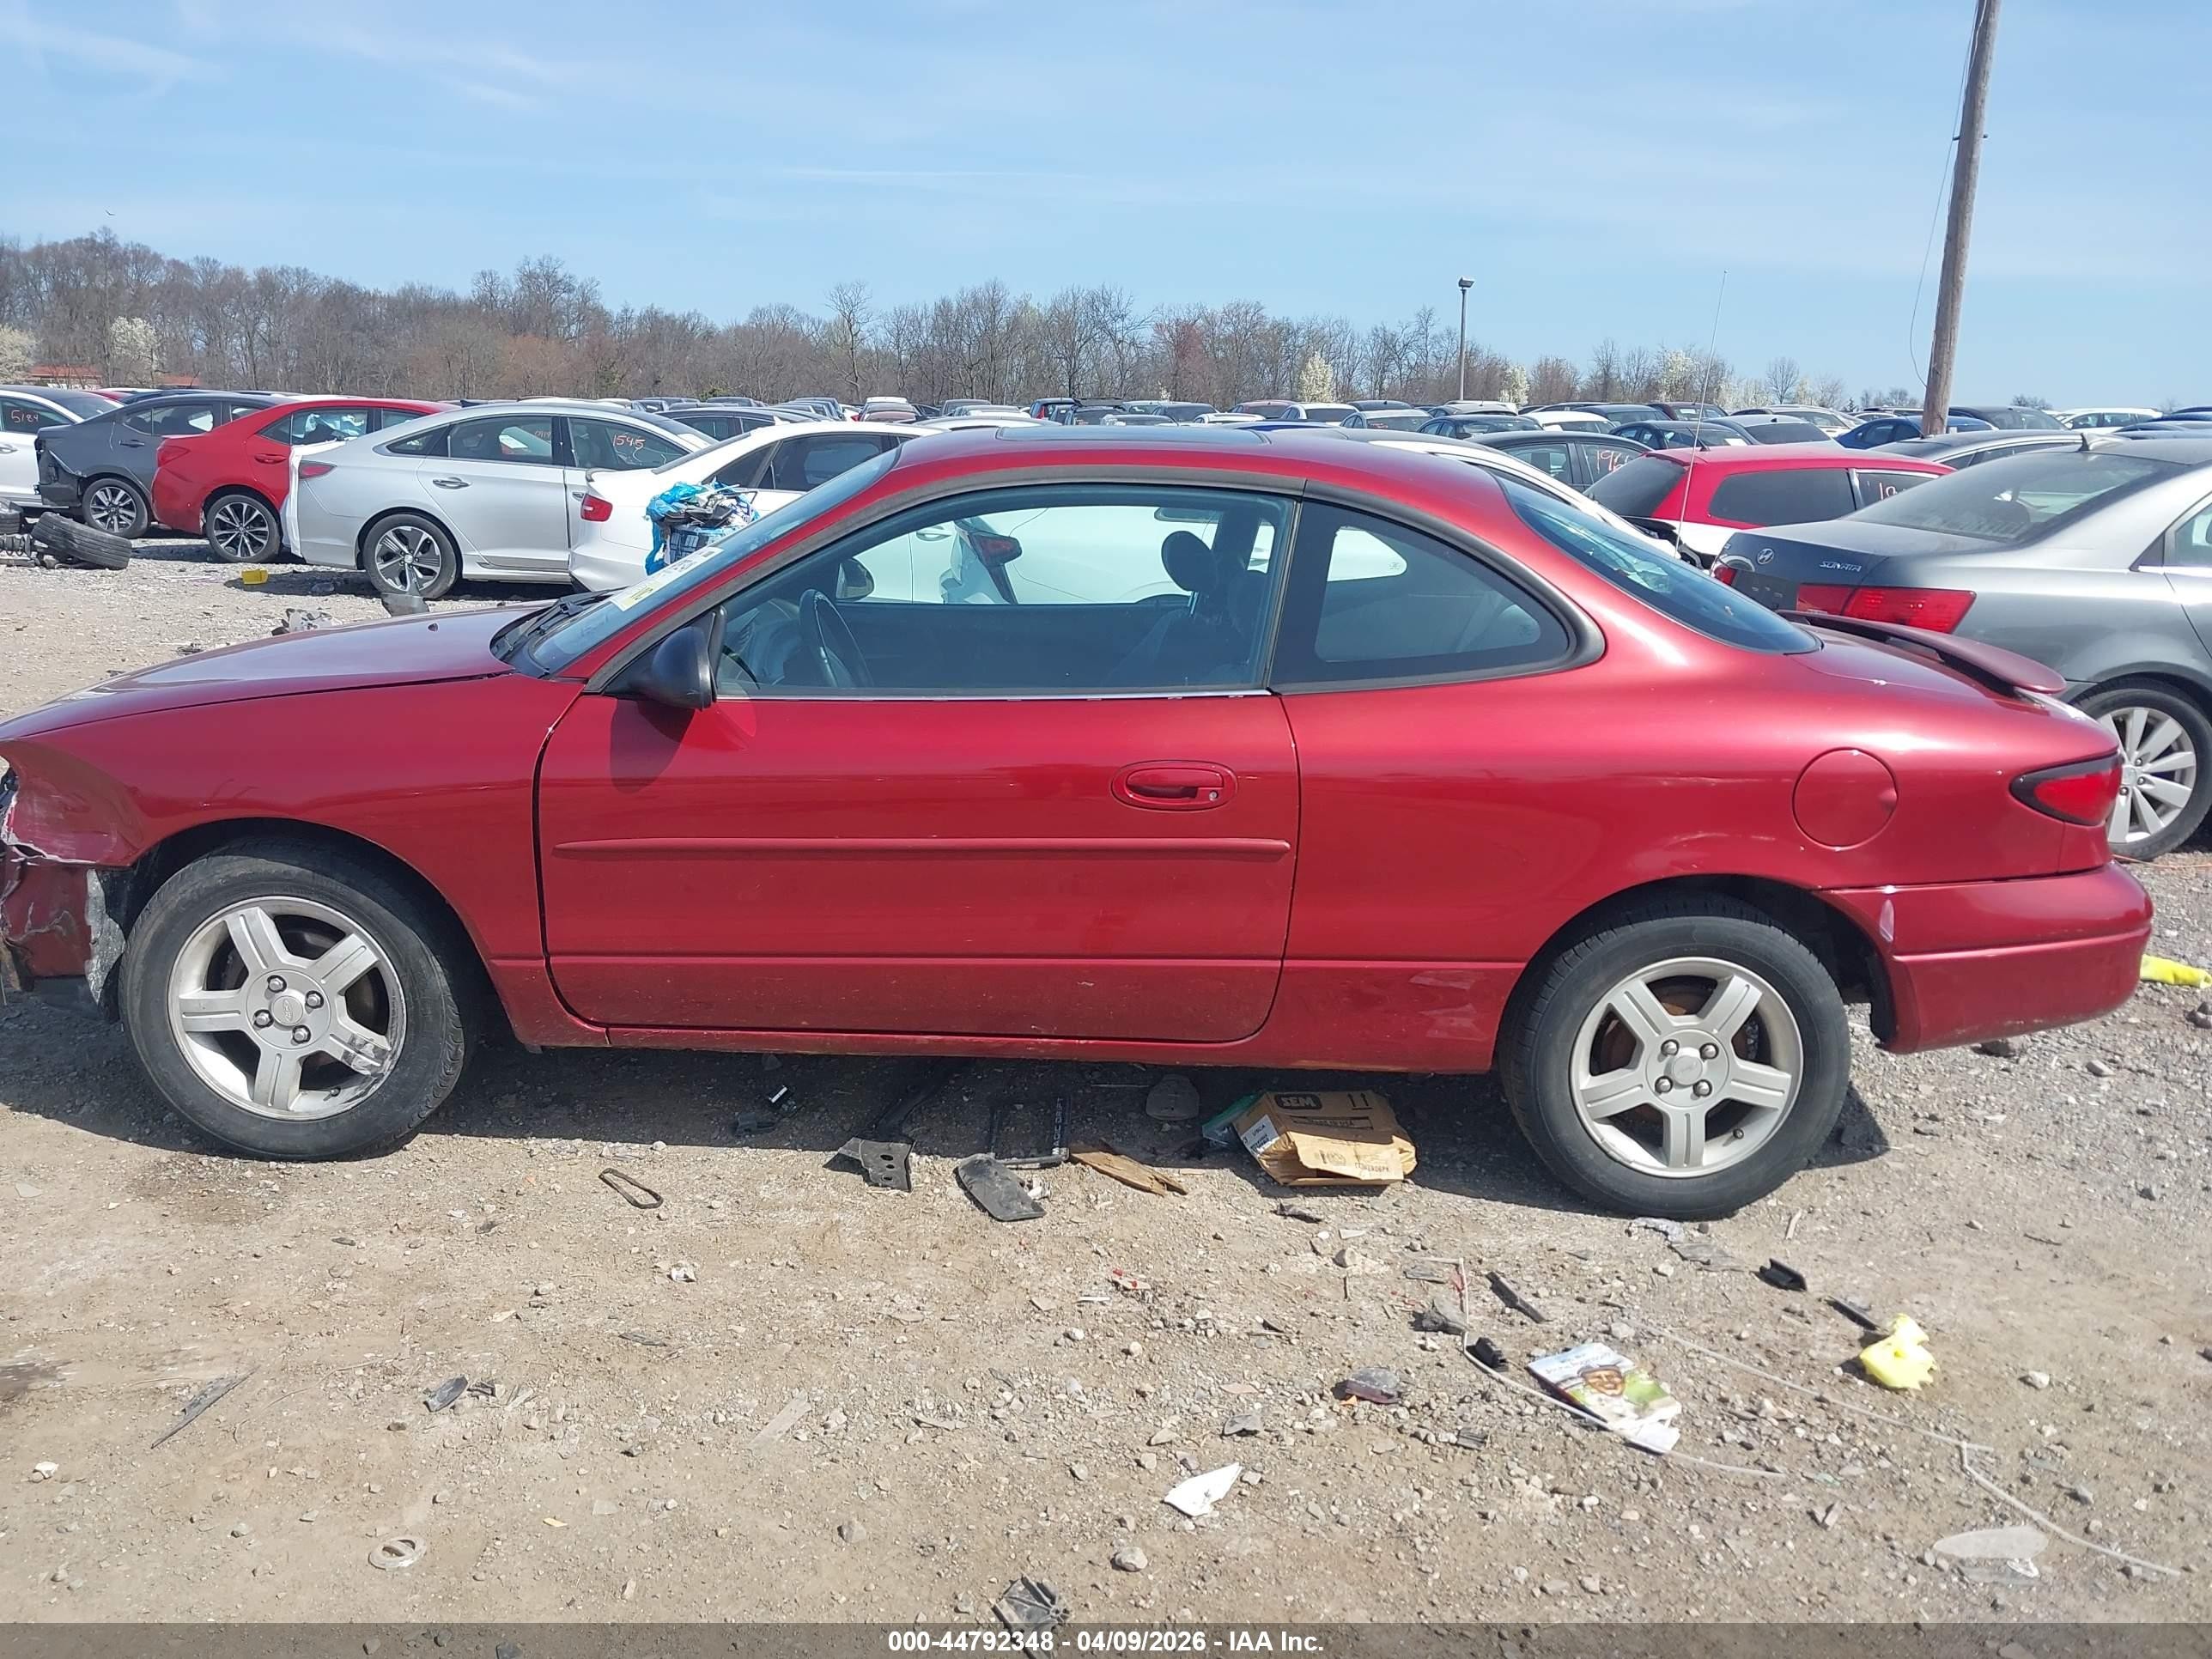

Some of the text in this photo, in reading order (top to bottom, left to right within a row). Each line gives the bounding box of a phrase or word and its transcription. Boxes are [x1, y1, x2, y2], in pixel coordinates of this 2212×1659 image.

[613, 434, 646, 448] 1545
[1819, 561, 1862, 572] SONATA
[1282, 1094, 1316, 1107] SEM
